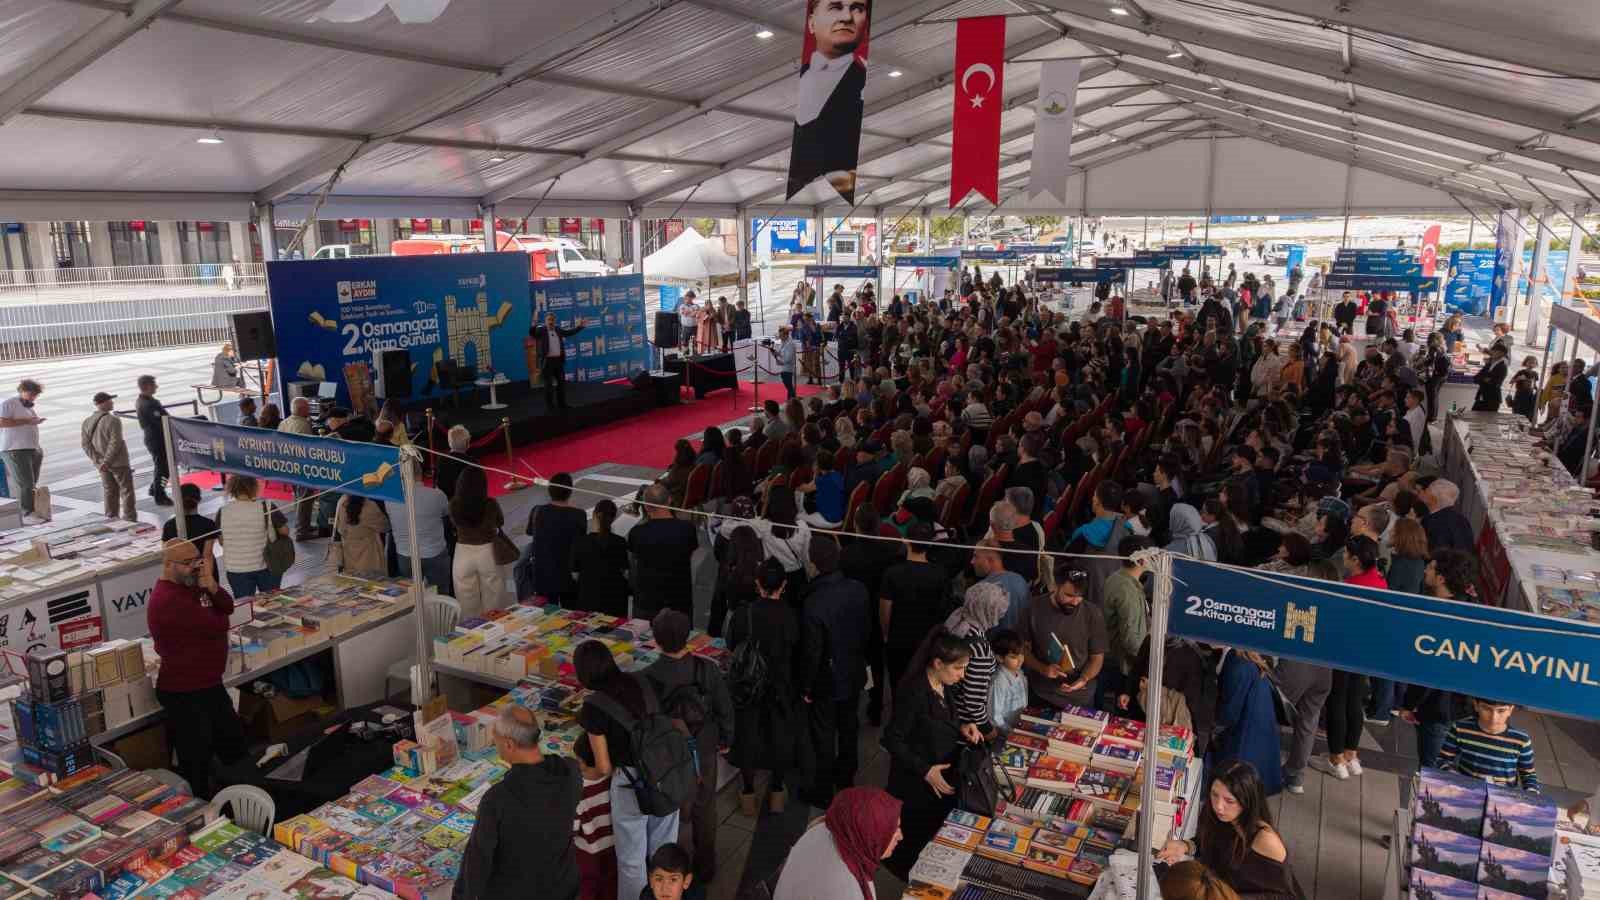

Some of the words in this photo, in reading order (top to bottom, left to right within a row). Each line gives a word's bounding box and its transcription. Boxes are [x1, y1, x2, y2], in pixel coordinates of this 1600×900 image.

[352, 280, 376, 289] ERKAN
[353, 288, 376, 298] AYDIN
[342, 323, 363, 355] 2.
[362, 313, 439, 337] Osmangazi
[363, 337, 398, 353] Kitap
[399, 330, 440, 348] Günleri
[239, 437, 275, 454] AYRINTI
[277, 442, 306, 459] YAYIN
[309, 447, 346, 464] GRUBU
[245, 454, 252, 467] &
[254, 454, 301, 475] DİNOZOR
[303, 464, 343, 482] ÇOCUK
[112, 588, 152, 612] YAY
[1184, 595, 1202, 616] 2.
[1203, 598, 1276, 620] Osmangazi
[1202, 608, 1233, 624] Kitap
[1234, 612, 1276, 630] Günleri
[1414, 634, 1480, 664] CAN
